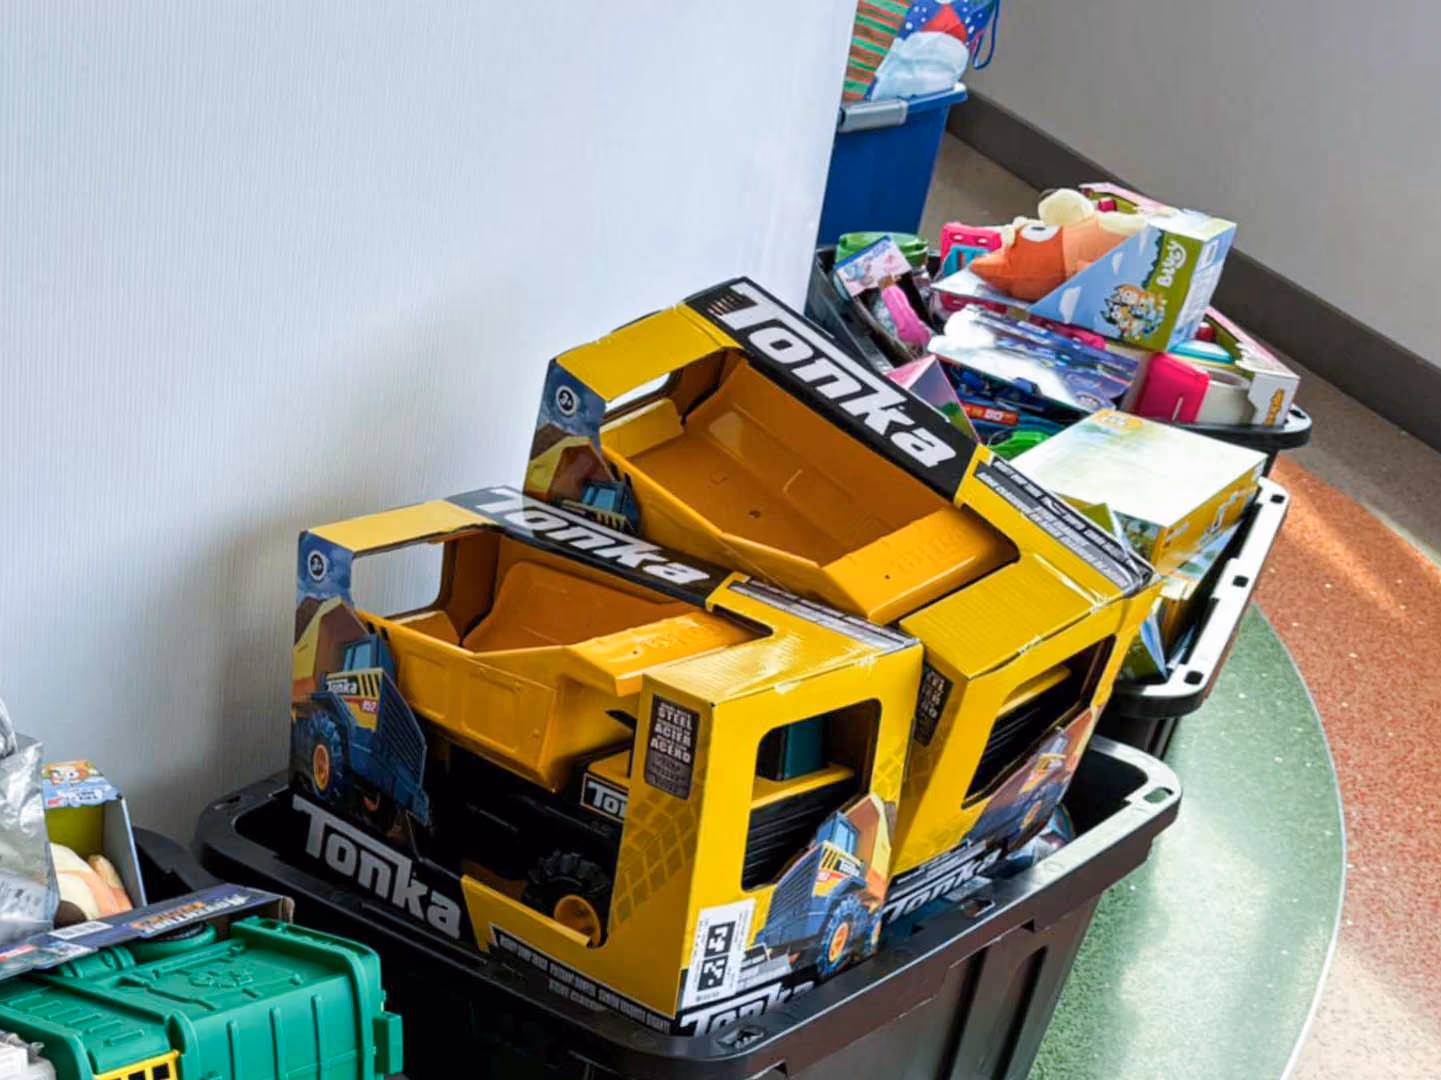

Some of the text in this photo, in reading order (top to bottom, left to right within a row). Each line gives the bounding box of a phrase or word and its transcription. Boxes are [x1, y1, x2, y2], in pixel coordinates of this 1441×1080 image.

[718, 281, 957, 468] Tonka
[476, 488, 711, 584] Tonka
[655, 723, 691, 747] ACIER
[658, 706, 692, 731] STEEL
[650, 738, 691, 763] ACERO
[292, 793, 461, 939] Tonka
